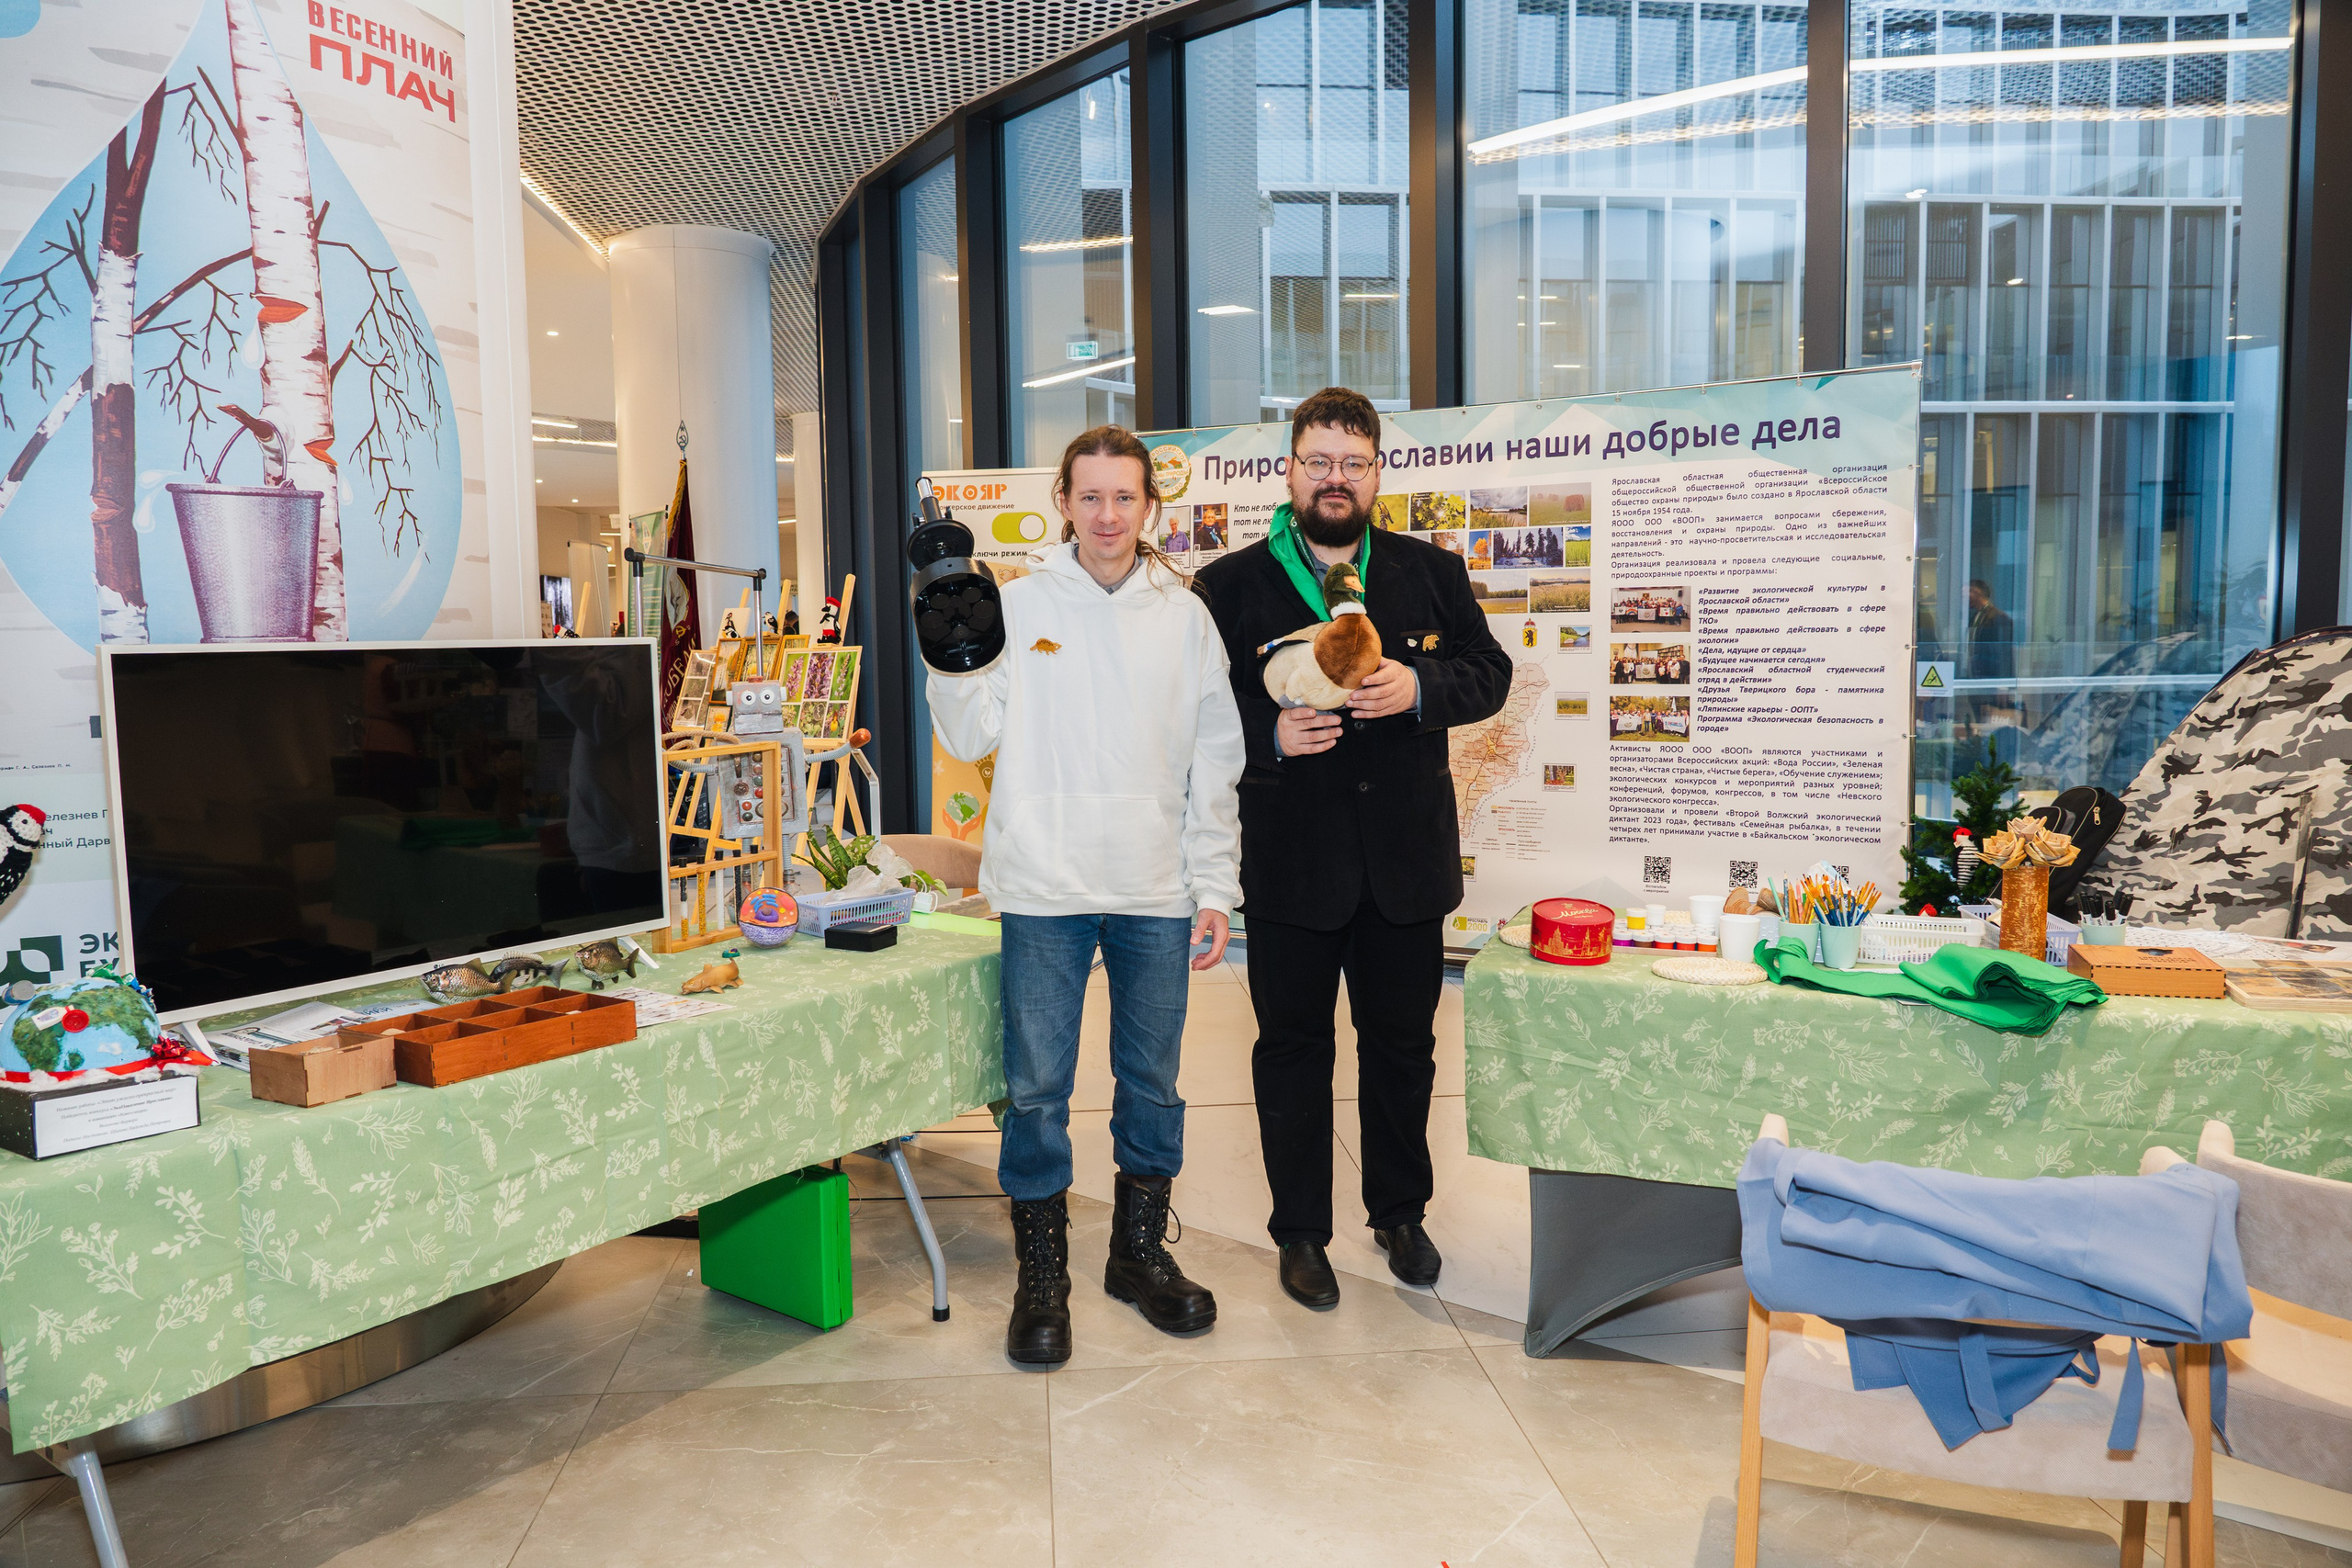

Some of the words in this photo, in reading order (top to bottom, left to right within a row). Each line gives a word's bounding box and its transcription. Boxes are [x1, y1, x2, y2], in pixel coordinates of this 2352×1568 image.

[308, 0, 453, 81] ВЕСЕННИЙ
[310, 34, 456, 123] ПЛАЧ
[1204, 456, 1287, 484] Приро
[1378, 442, 1493, 467] ославии
[1507, 434, 1590, 460] наши
[1602, 420, 1740, 459] добрые
[1752, 415, 1840, 450] дела
[1611, 477, 1660, 486] Ярославская
[1682, 473, 1724, 481] областная
[1747, 468, 1807, 478] общественная
[1832, 464, 1887, 474] организация
[1611, 485, 1676, 496] общероссийской
[1685, 481, 1745, 491] общественной
[1754, 479, 1808, 489] организации
[1818, 475, 1887, 485] «Всероссийское
[1611, 498, 1649, 506] общество
[1651, 497, 1679, 505] охраны
[1682, 495, 1723, 503] природы»
[1750, 491, 1784, 500] создано
[1795, 487, 1849, 498] Ярославской
[1852, 486, 1887, 494] области
[1234, 504, 1250, 513] Кто
[1623, 508, 1650, 516] ноября
[1653, 506, 1670, 514] 1954
[1233, 518, 1251, 526] тот
[1645, 517, 1662, 525] ООО
[1672, 515, 1704, 524] «ВООП»
[1774, 512, 1820, 520] вопросами
[1831, 509, 1886, 518] сбережения,
[1611, 529, 1672, 537] восстановления
[1785, 523, 1807, 531] Одно
[1837, 519, 1886, 528] важнейших
[1611, 538, 1661, 548] направлений
[1689, 535, 1793, 546] научно-просветительская
[1804, 531, 1885, 540] исследовательская
[1611, 550, 1664, 558] деятельность.
[1611, 560, 1660, 570] Организация
[1665, 558, 1716, 568] реализовала
[1771, 556, 1820, 564] следующие
[1831, 554, 1885, 562] социальные,
[1611, 570, 1681, 580] природоохранные
[1683, 570, 1717, 578] проекты
[1751, 584, 1814, 593] экологической
[1826, 585, 1867, 593] культуры
[1698, 596, 1749, 606] Ярославской
[1751, 595, 1790, 604] области»
[1698, 607, 1728, 615] «Время
[1736, 607, 1780, 615] правильно
[1786, 605, 1839, 615] действовать
[1860, 604, 1886, 613] сфере
[1698, 626, 1728, 636] «Время
[1786, 625, 1838, 634] действовать
[1859, 625, 1885, 634] сфере
[1697, 646, 1724, 655] «Дела,
[1697, 656, 1737, 665] «Будущее
[1697, 665, 1754, 674] «Ярославский
[1768, 665, 1812, 673] областной
[1826, 665, 1885, 674] студенческий
[1728, 675, 1772, 684] действии»
[1697, 685, 1730, 694] «Друзья
[1739, 685, 1786, 694] Тверицкого
[1795, 685, 1815, 694] бора
[1696, 715, 1743, 723] Программа
[1747, 715, 1812, 723] «Экологическая
[1816, 716, 1873, 724] безопасность
[1609, 744, 1651, 752] Активисты
[1659, 745, 1683, 753] ЯООО
[1720, 746, 1753, 754] «ВООП»
[1811, 750, 1867, 758] участниками
[1609, 755, 1673, 763] организаторами
[1677, 755, 1738, 765] Всероссийских
[1742, 758, 1770, 766] акций:
[1773, 758, 1797, 767] «Вода
[1802, 759, 1838, 768] России»,
[1842, 760, 1883, 768] «Зеленая
[1671, 767, 1705, 775] страна»,
[1706, 767, 1741, 775] «Чистые
[1742, 767, 1777, 777] берега»,
[1779, 769, 1825, 778] «Обучение
[1826, 772, 1883, 780] служением»;
[1737, 780, 1794, 788] мероприятий
[1842, 782, 1883, 790] уровней;
[1609, 784, 1665, 794] конференций,
[1670, 786, 1709, 795] форумов,
[1714, 789, 1764, 797] конгрессов,
[1837, 792, 1882, 800] «Невского
[46, 812, 98, 821] елезнев
[1609, 804, 1665, 813] Организовали
[1725, 808, 1759, 818] «Второй
[1767, 810, 1808, 819] Волжский
[1815, 814, 1881, 822] экологический
[76, 838, 110, 848] Дарв
[1467, 923, 1487, 931] 2000
[79, 931, 119, 953] ЭК
